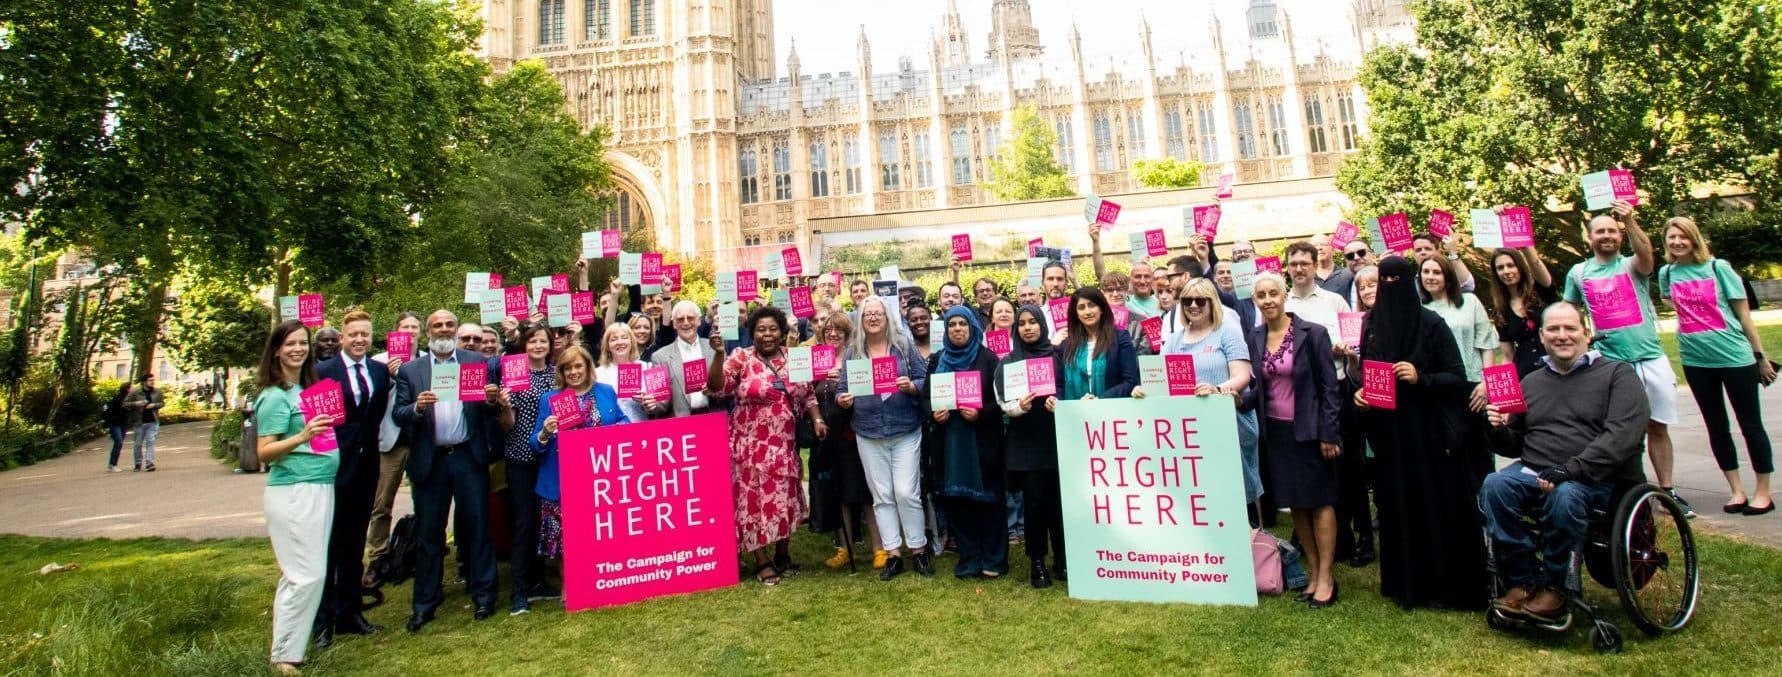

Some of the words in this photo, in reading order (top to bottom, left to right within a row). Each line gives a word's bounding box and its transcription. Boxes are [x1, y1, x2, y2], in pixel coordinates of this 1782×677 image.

[1365, 368, 1390, 377] WE'RE
[1366, 375, 1391, 384] RIGHT
[1486, 371, 1512, 382] WE'RE
[314, 389, 339, 401] WE'RE
[1488, 379, 1513, 389] RIGHT
[315, 397, 340, 407] RIGHT
[1085, 418, 1200, 450] WE'RE
[590, 434, 698, 474] WE'RE
[1090, 456, 1203, 487] RIGHT
[594, 466, 700, 507] RIGHT
[595, 498, 715, 541] HERE.
[1094, 494, 1224, 527] HERE.
[596, 562, 622, 574] The
[627, 550, 693, 569] Campaign
[697, 546, 715, 557] for
[1096, 550, 1122, 562] The
[1128, 551, 1199, 566] Campaign
[1204, 553, 1224, 564] for
[596, 569, 672, 590] Community
[677, 561, 717, 576] Power
[1097, 568, 1176, 583] Community
[1182, 571, 1228, 582] Power
